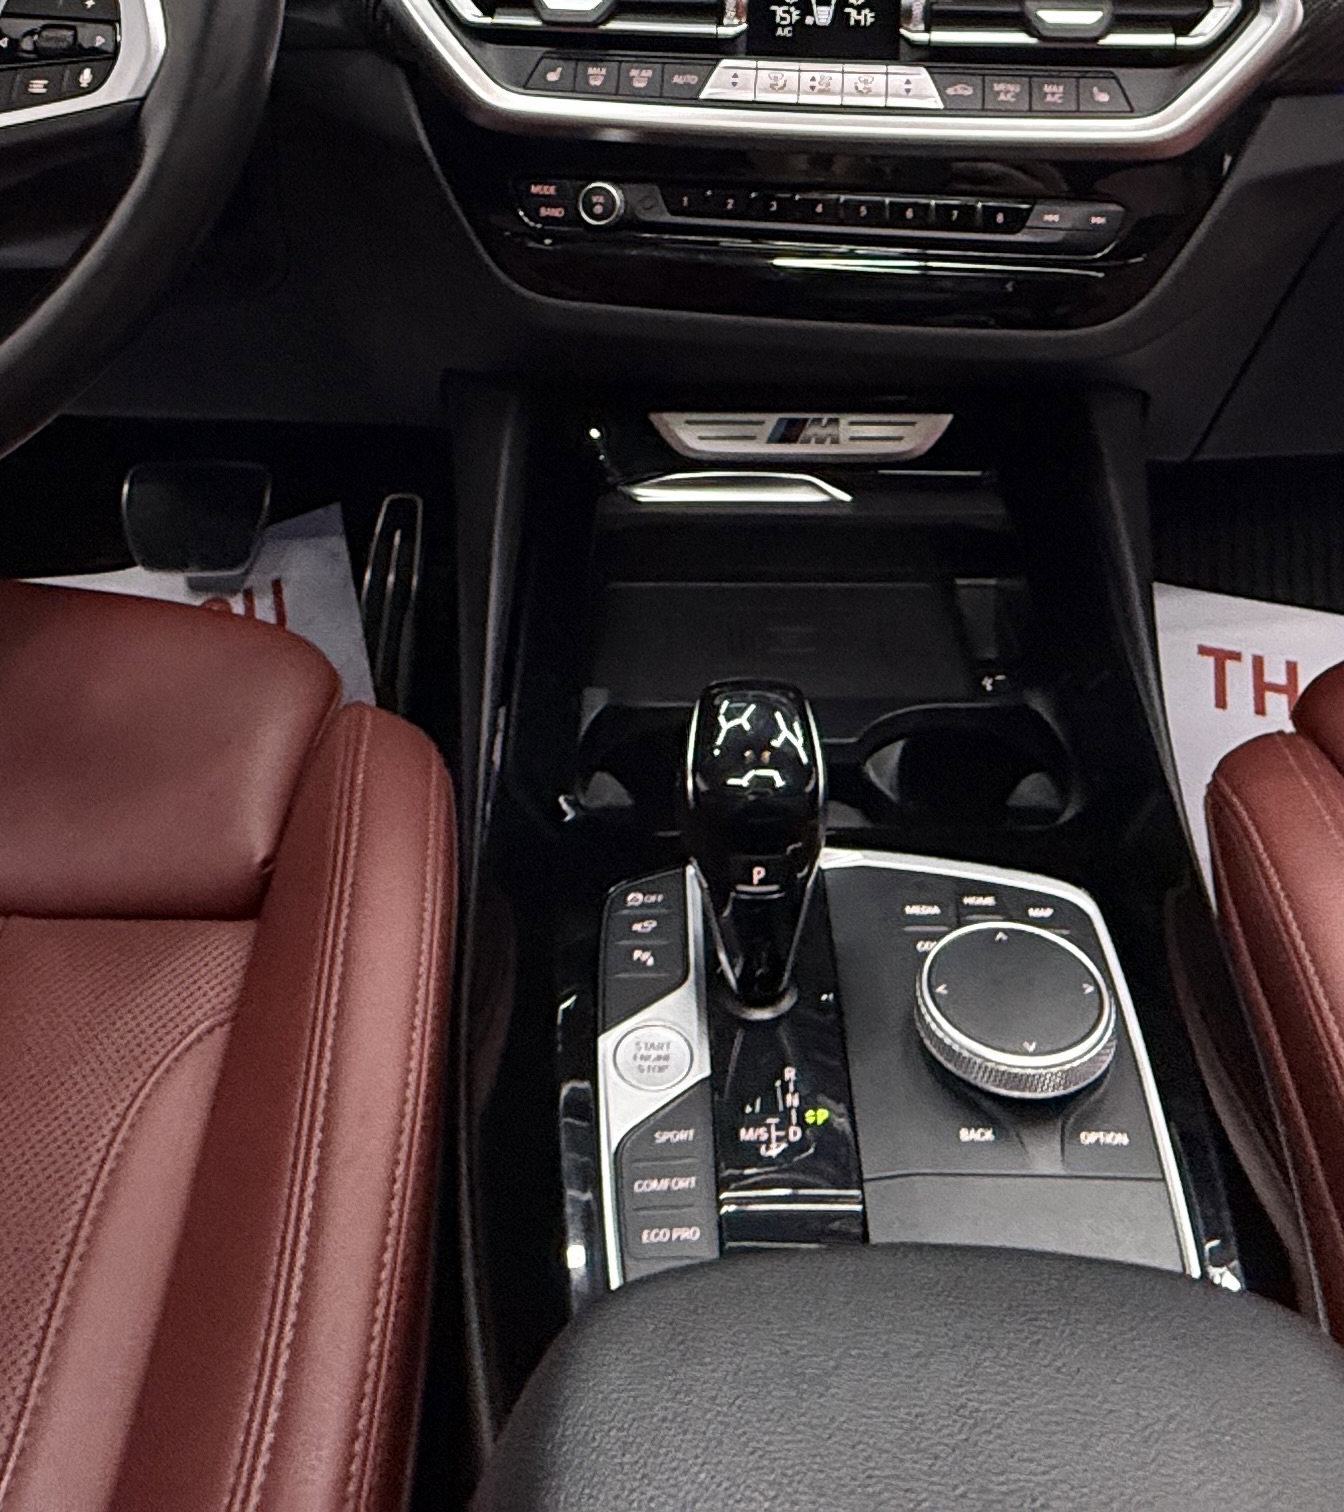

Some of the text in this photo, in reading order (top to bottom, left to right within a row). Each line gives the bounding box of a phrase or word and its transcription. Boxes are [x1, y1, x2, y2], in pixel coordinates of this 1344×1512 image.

[752, 866, 766, 885] P
[654, 1128, 695, 1143] SPORT
[788, 1126, 802, 1143] D
[959, 1127, 995, 1142] BACK
[1079, 1131, 1130, 1146] OPTION
[633, 1177, 697, 1193] COMFORT
[641, 1226, 701, 1244] ECO PRO
